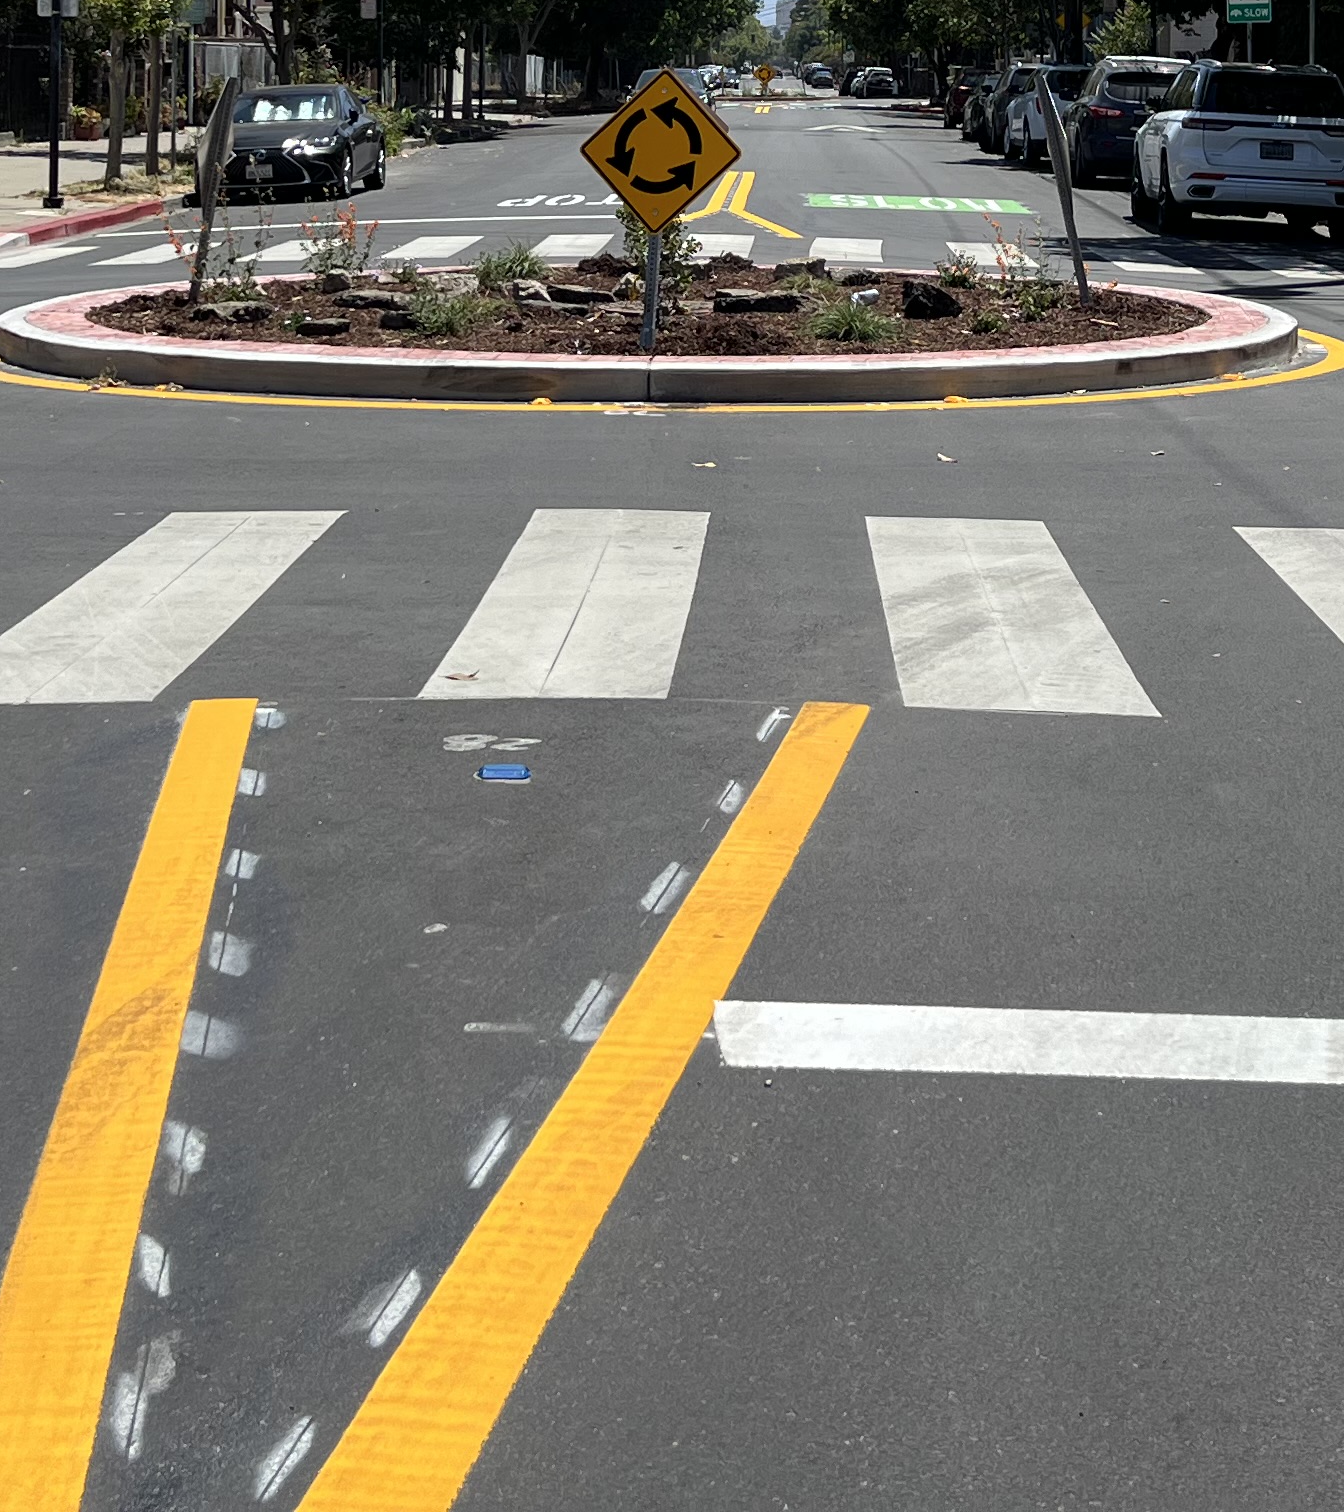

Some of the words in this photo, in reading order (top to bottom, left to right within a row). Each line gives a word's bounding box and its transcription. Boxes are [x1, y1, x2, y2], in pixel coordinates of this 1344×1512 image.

[1244, 7, 1269, 18] SLOW
[497, 194, 624, 207] TOP
[829, 194, 1004, 213] SLOW
